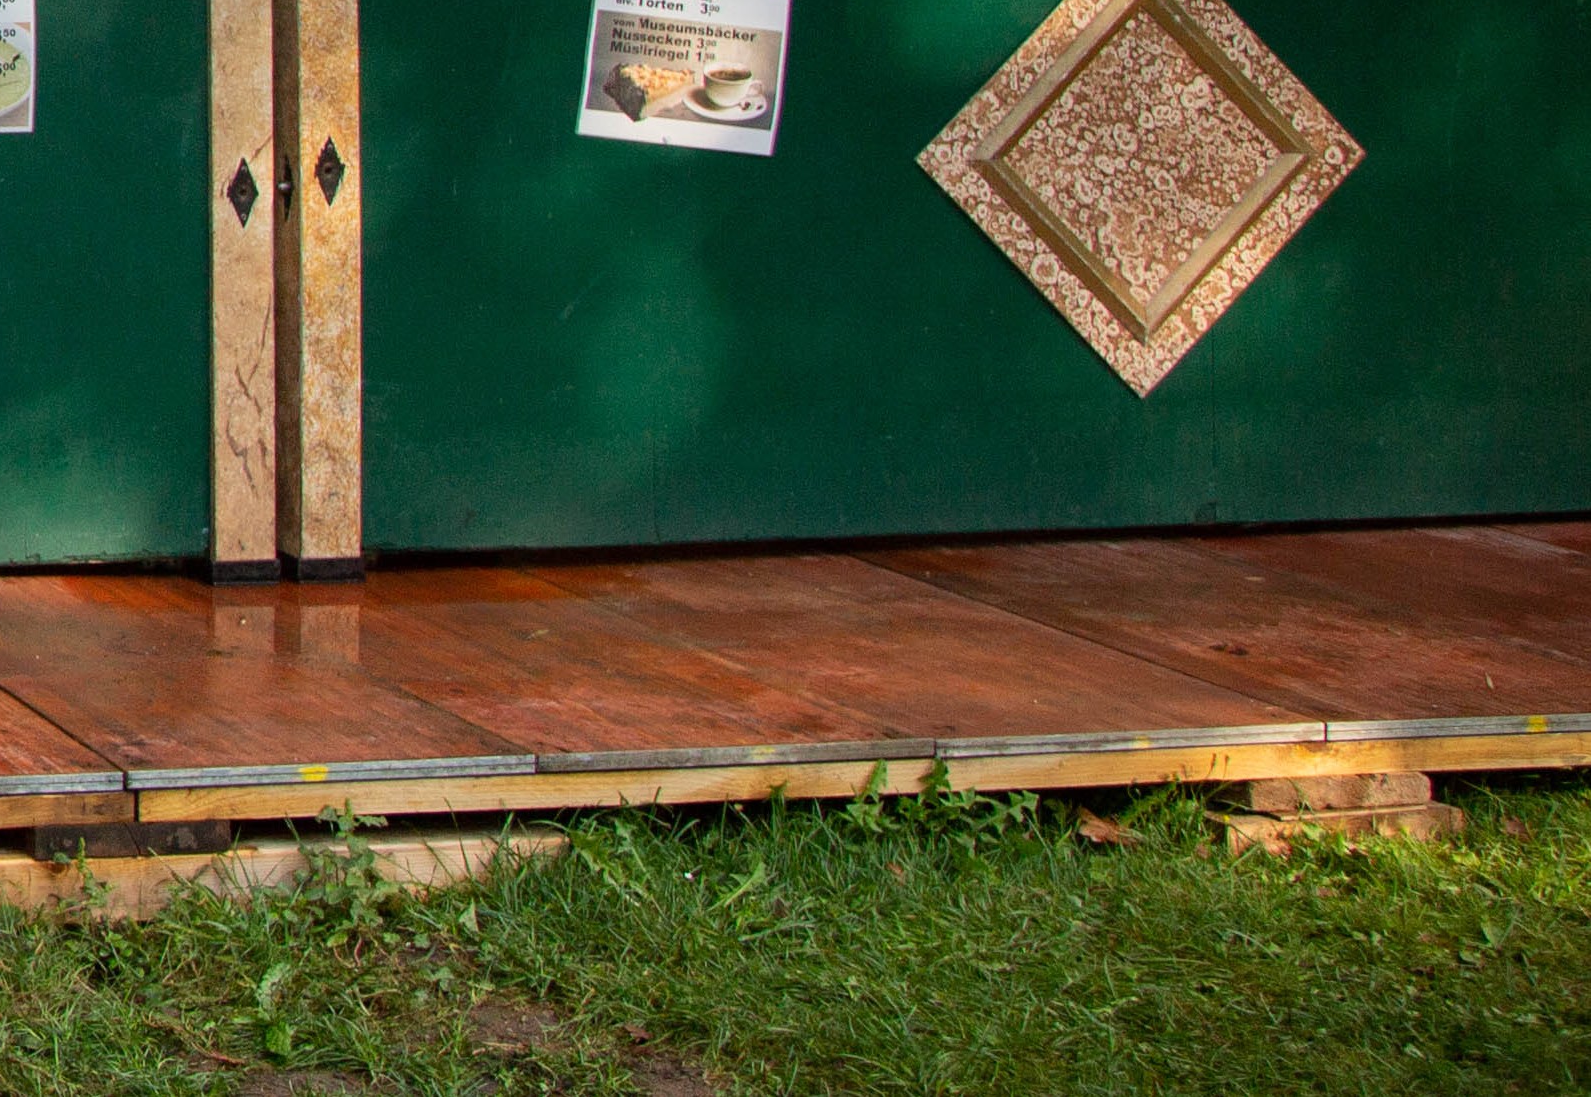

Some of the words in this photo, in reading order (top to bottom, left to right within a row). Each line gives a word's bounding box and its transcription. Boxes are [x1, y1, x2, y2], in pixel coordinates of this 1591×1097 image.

[612, 28, 691, 48] Nussecken
[613, 18, 635, 27] vom
[639, 18, 757, 42] Museumsbäcker
